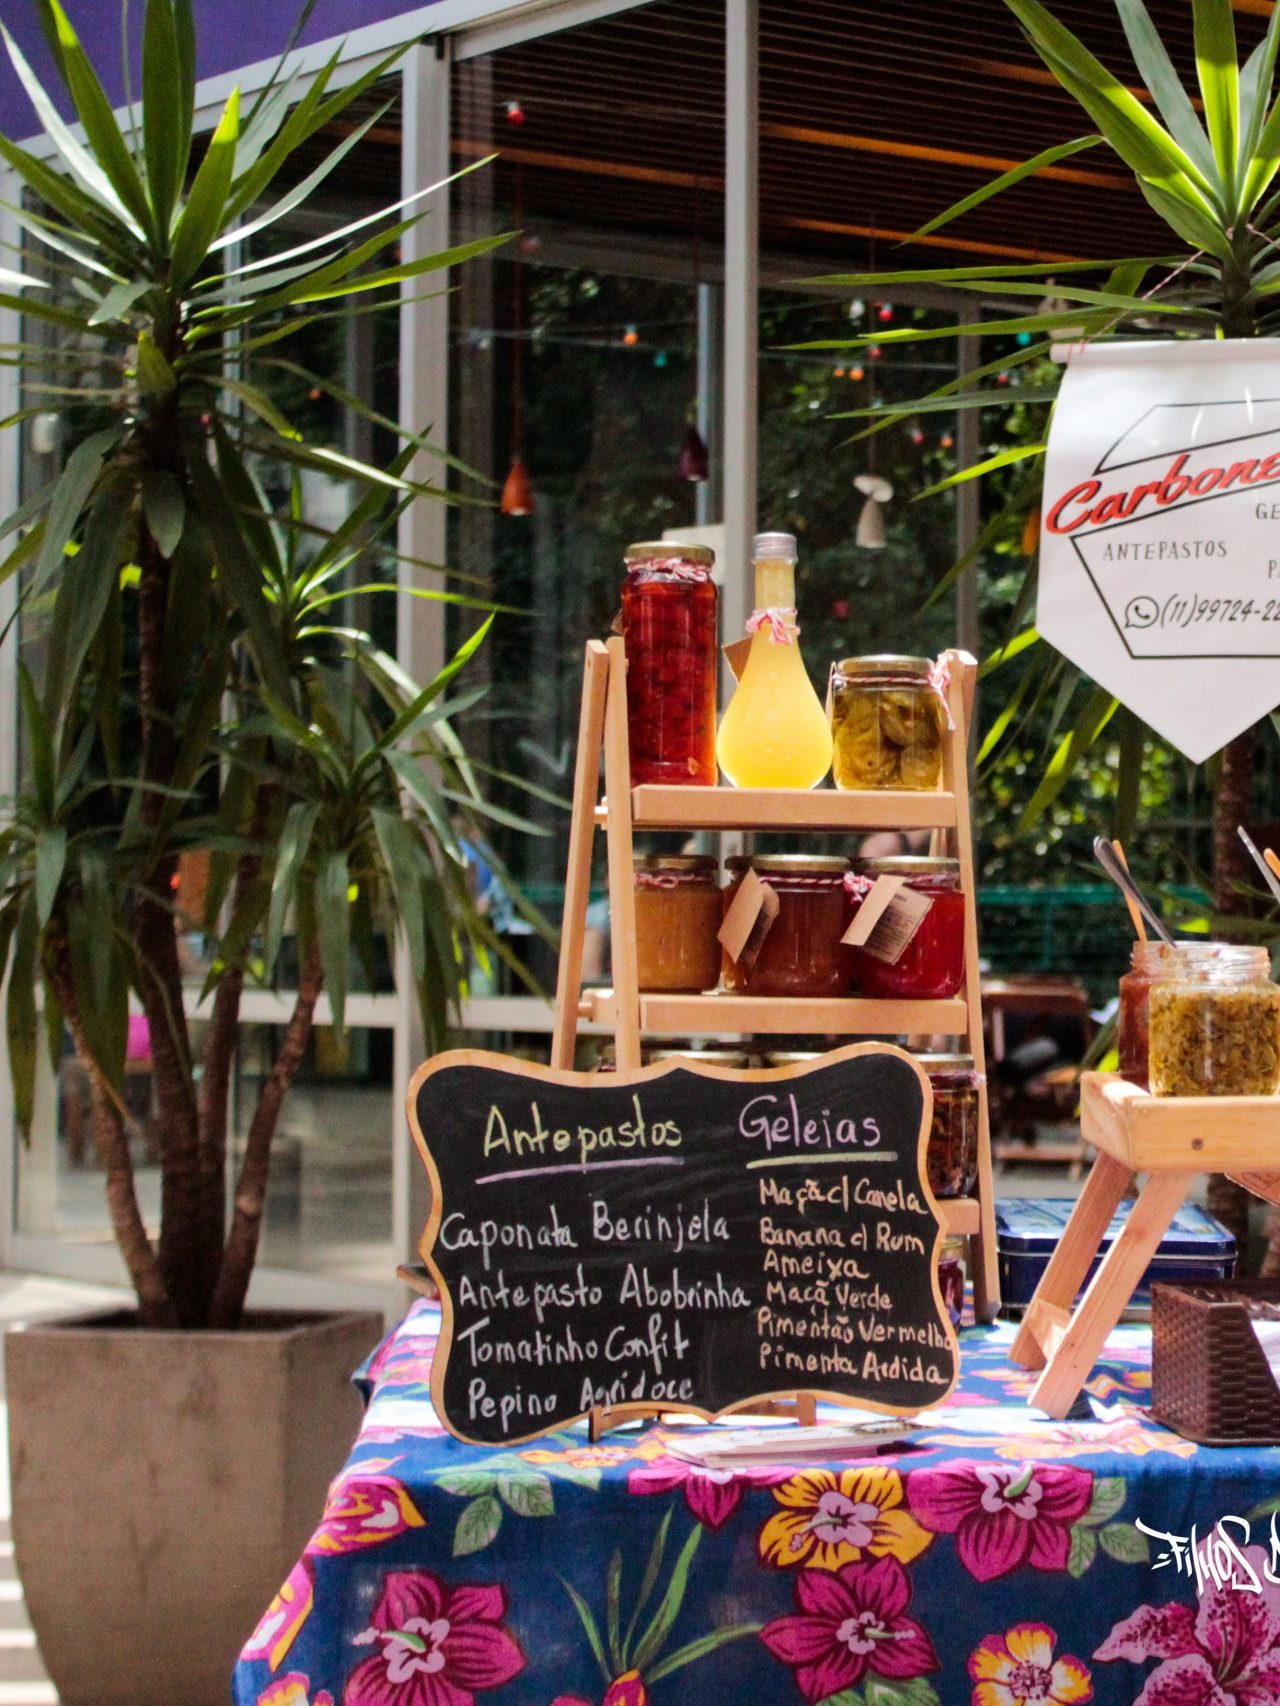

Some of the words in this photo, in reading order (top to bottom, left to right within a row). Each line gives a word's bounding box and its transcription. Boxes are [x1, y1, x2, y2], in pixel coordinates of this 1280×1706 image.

[1102, 540, 1228, 562] ANTEPASTOS
[484, 1093, 682, 1174] Antepastos
[739, 1093, 881, 1150] Geleias
[759, 1177, 826, 1216] Maçã
[854, 1177, 929, 1215] Canela
[440, 1204, 579, 1270] Caponata
[592, 1198, 731, 1253] Berinjela
[760, 1216, 846, 1250] Banana
[876, 1221, 925, 1256] Rum
[763, 1248, 870, 1281] Ameixa
[458, 1263, 603, 1323] Antepasto
[620, 1263, 752, 1310] Abobrinha
[766, 1280, 830, 1316] Maçã
[835, 1281, 894, 1311] Verde
[457, 1316, 599, 1367] Tomatinho
[604, 1312, 690, 1375] Confit
[757, 1305, 854, 1344] Pimentão
[858, 1313, 952, 1350] Vermelho
[759, 1341, 858, 1375] Pimenta
[861, 1350, 950, 1385] Ardida
[468, 1377, 557, 1434] Pepino
[579, 1370, 694, 1416] Agridoce
